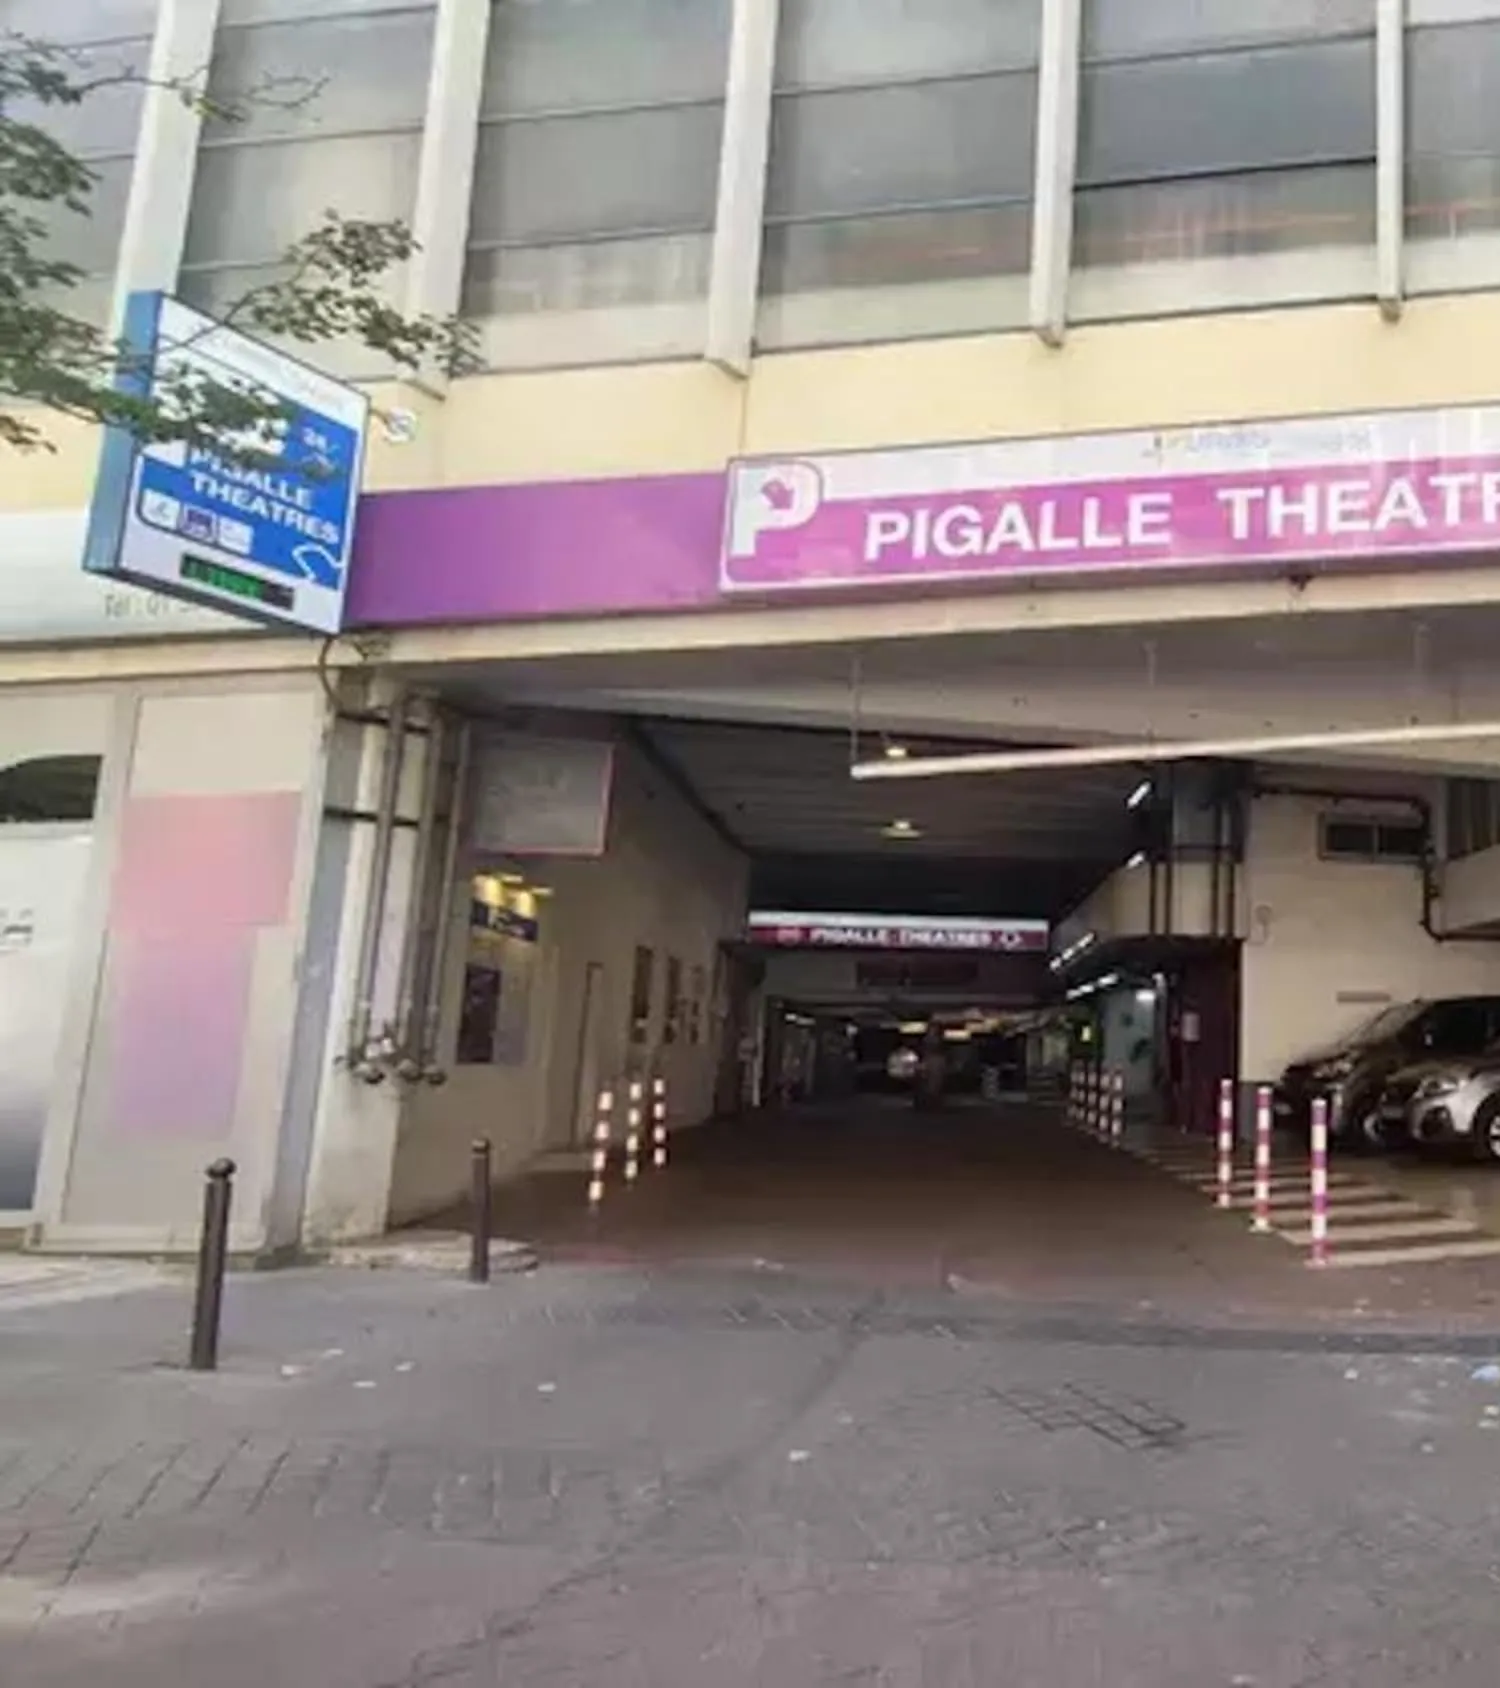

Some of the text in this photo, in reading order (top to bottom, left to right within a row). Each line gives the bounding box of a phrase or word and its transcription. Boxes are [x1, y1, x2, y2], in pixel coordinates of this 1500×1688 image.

[189, 468, 340, 545] THEATRES
[864, 493, 1173, 562] PIGALLE
[808, 925, 888, 947] PIGALLE
[898, 928, 993, 949] THEATRES
